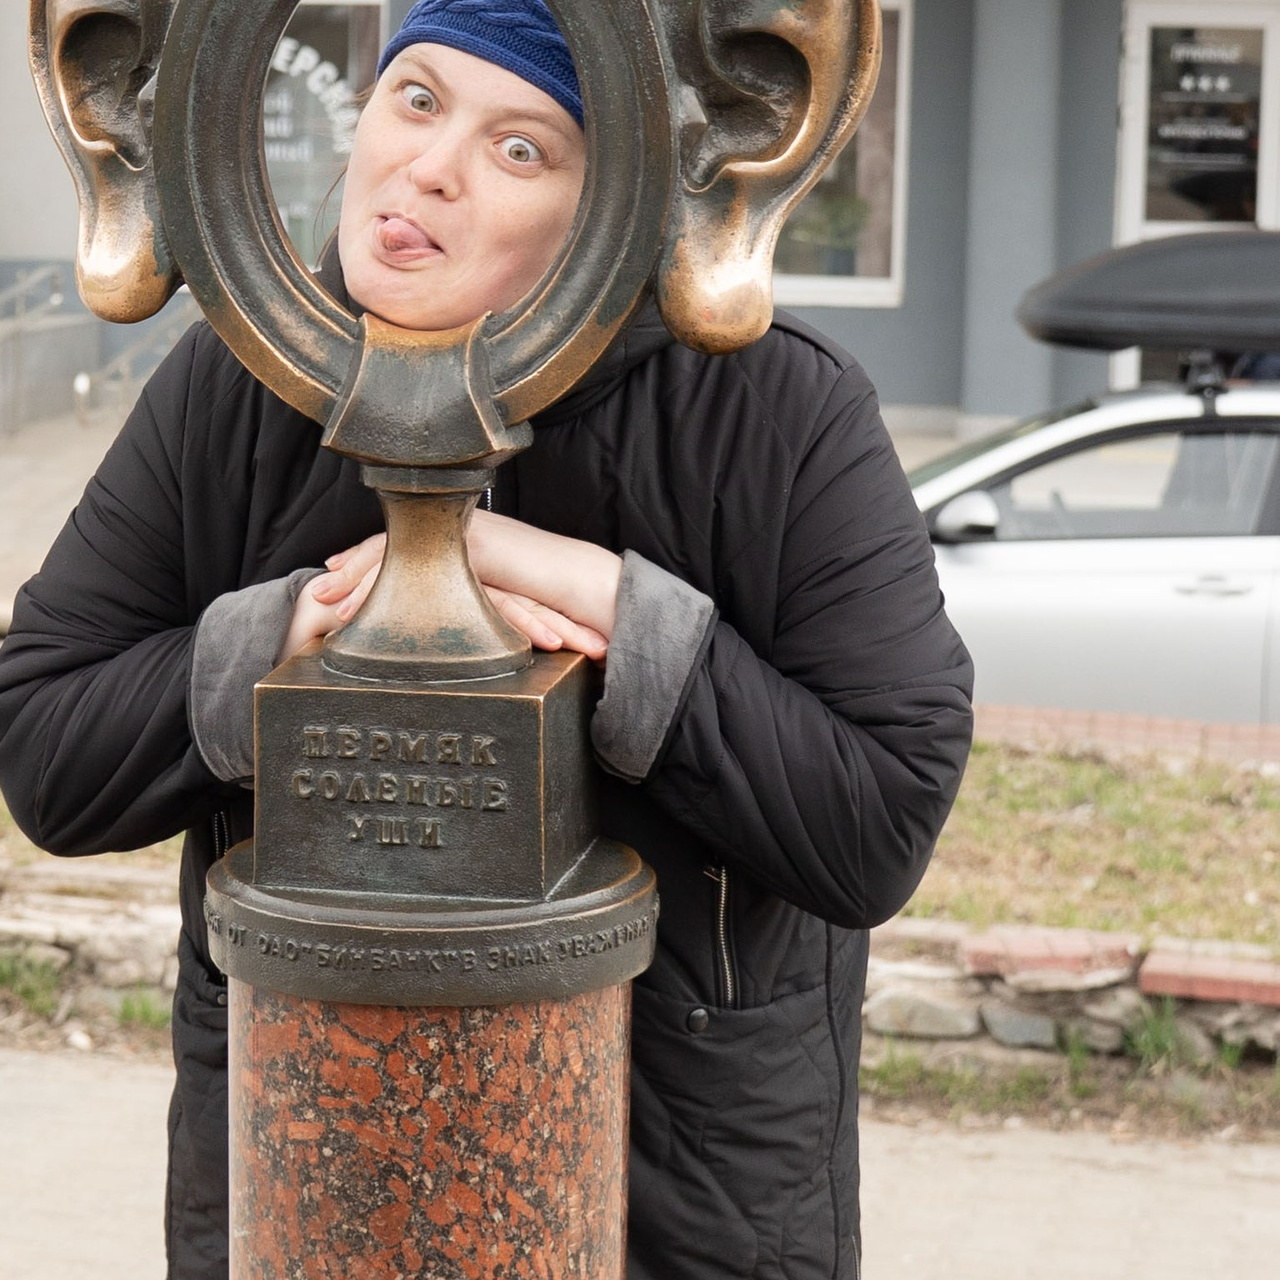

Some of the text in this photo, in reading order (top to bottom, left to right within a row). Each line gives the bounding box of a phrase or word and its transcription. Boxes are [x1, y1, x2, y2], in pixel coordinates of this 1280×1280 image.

[303, 725, 498, 766] ПЕРМЯК
[291, 768, 509, 812] СОЛЕНЫЕ
[347, 813, 444, 848] УШИ
[257, 932, 299, 962] ОАО
[460, 948, 477, 973] В
[486, 939, 553, 970] ЗНАК
